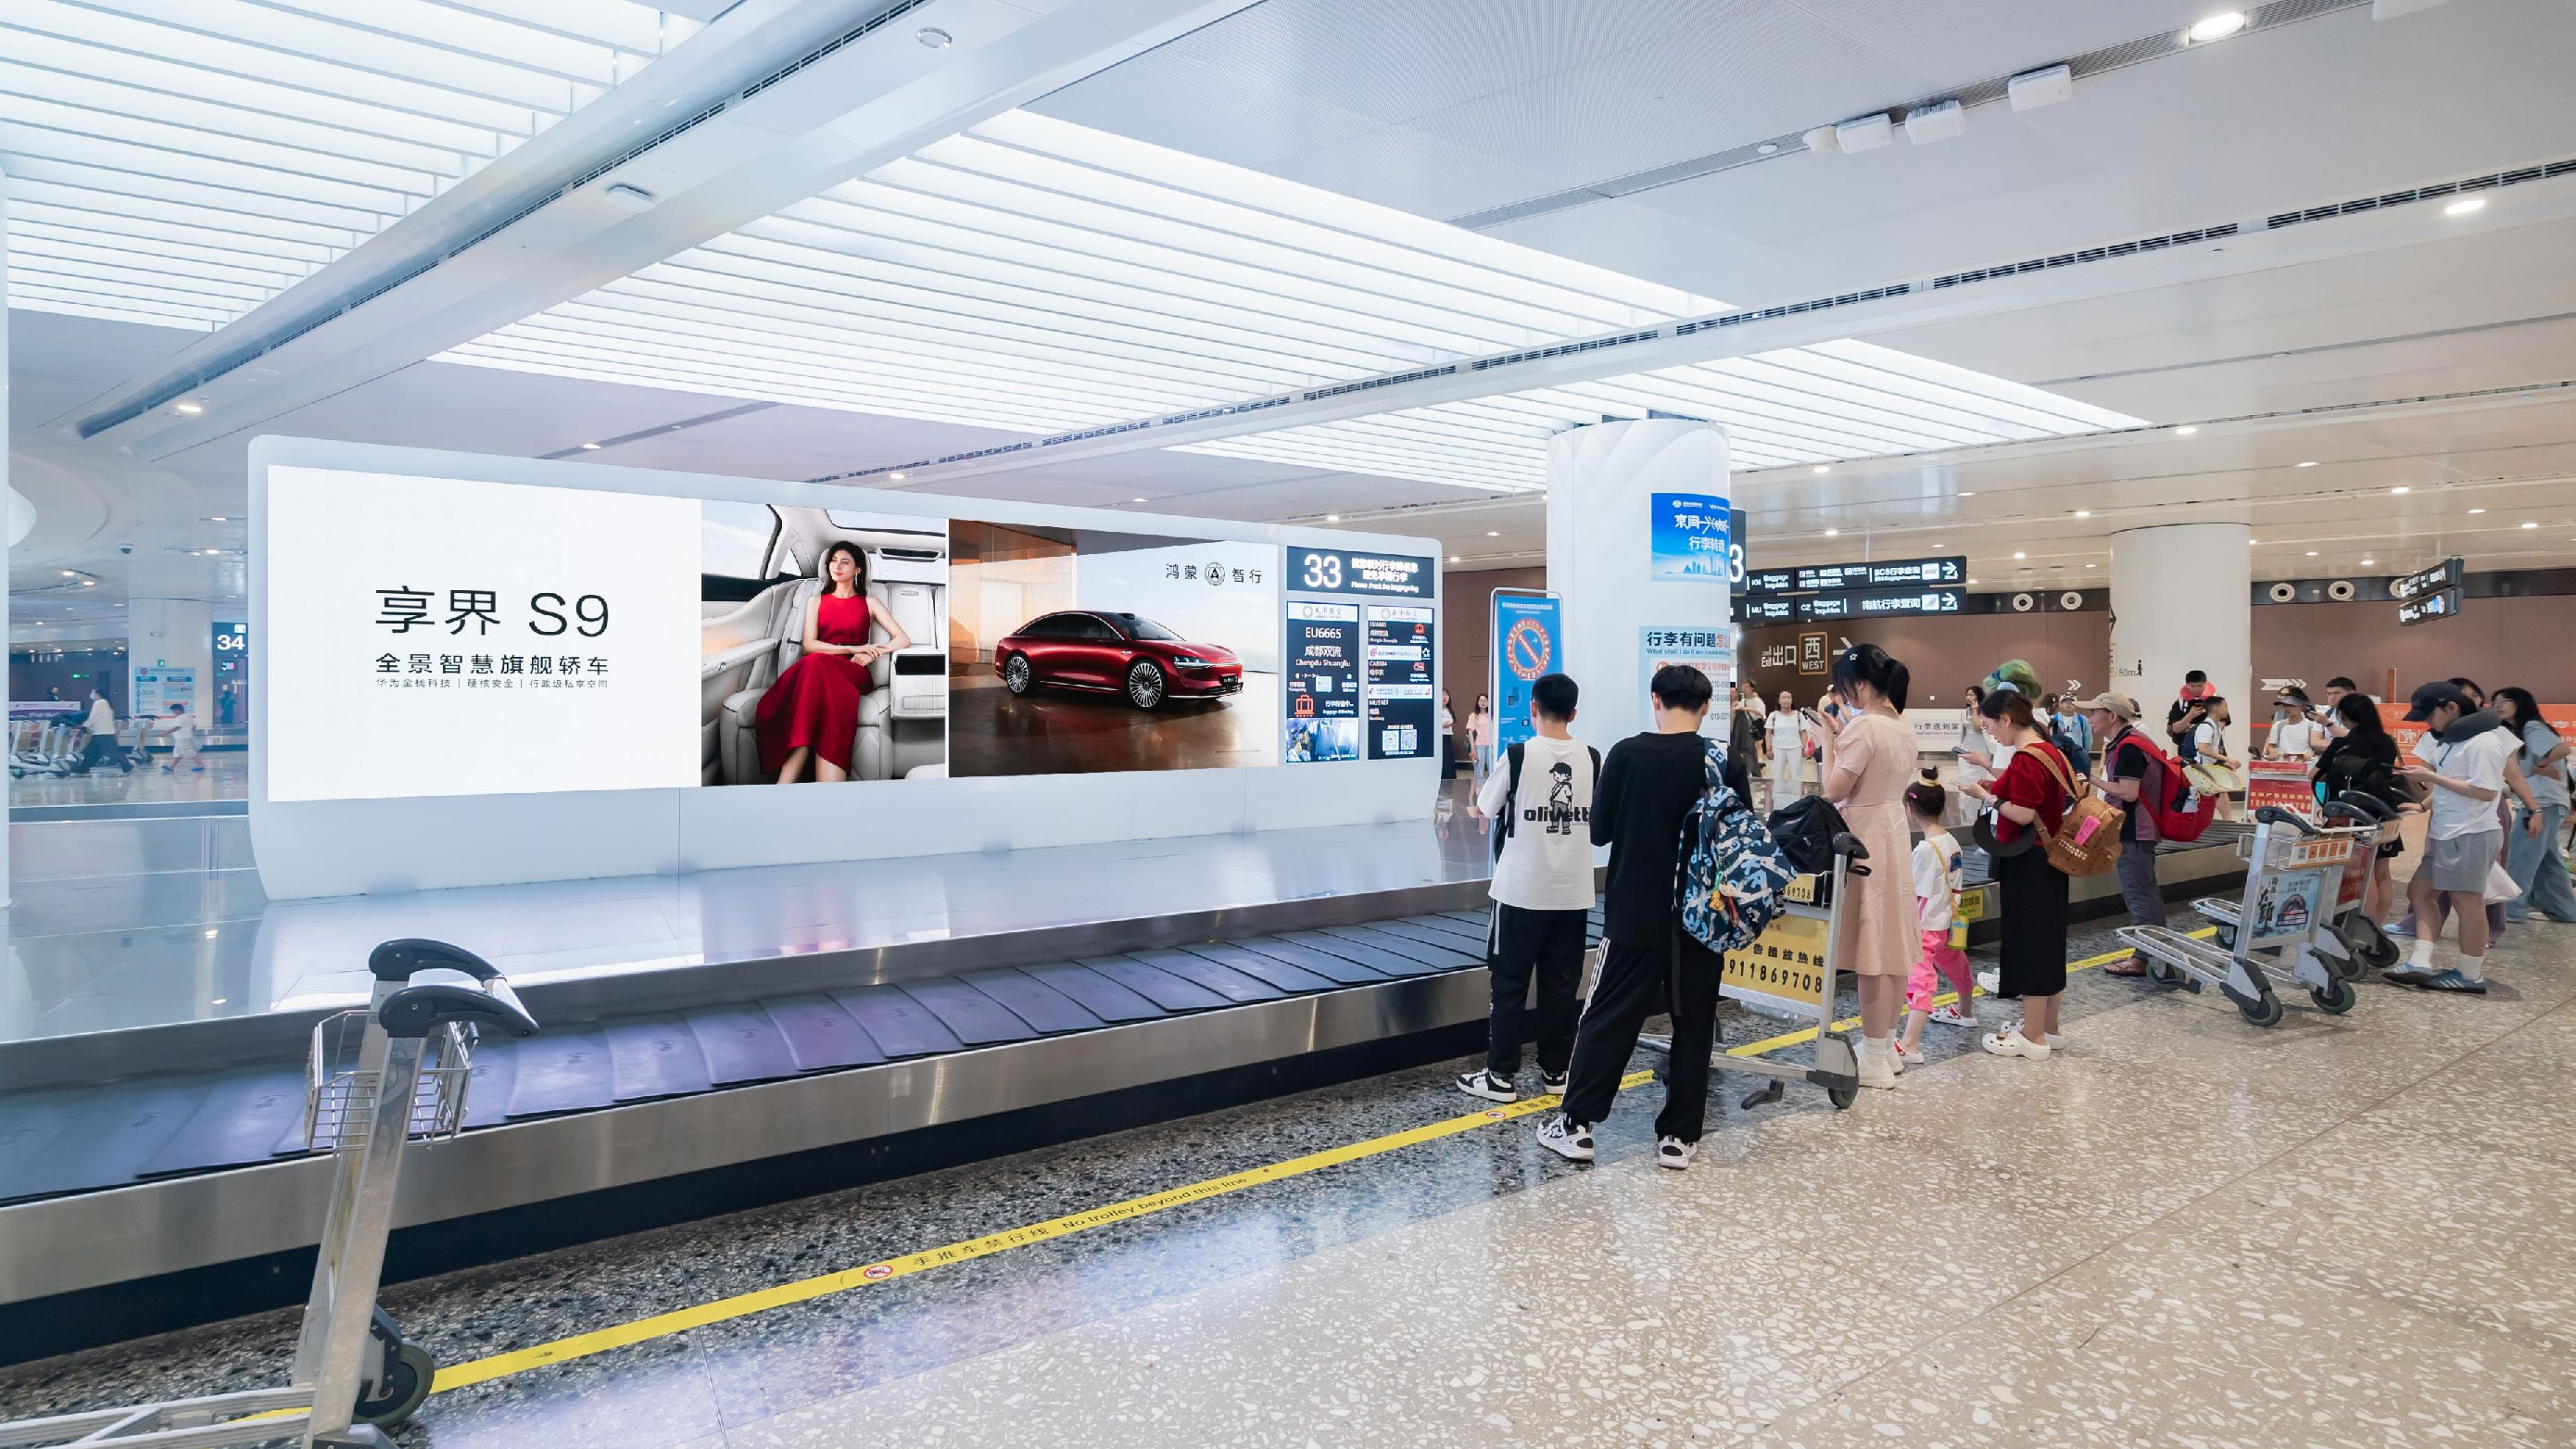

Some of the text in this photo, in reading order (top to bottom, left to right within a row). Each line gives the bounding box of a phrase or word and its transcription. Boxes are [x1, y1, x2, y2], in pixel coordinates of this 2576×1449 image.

[1166, 563, 1262, 584] 鸿蒙 智行
[1304, 554, 1342, 587] 33
[1751, 578, 1762, 586] KN
[375, 585, 609, 637] 享界 S9
[1800, 603, 1812, 611] CZ
[1305, 626, 1342, 639] EU6665
[217, 635, 246, 650] 34
[1305, 645, 1343, 658] 成都双流
[1805, 637, 1821, 660] 西
[375, 652, 609, 675] 全景智慧旗舰轿车
[1295, 659, 1351, 669] Chengdu Shuangliu
[1773, 645, 1797, 666] 出口
[1802, 661, 1824, 670] WEST
[467, 678, 513, 688] 硬核安全
[529, 679, 608, 688] 行政级私享空间
[1523, 806, 1590, 823] olivett
[1729, 959, 1823, 993] 911869708
[1062, 1217, 1085, 1229] No
[1089, 1206, 1135, 1222] trolley
[1138, 1191, 1192, 1209] beyond
[1193, 1185, 1219, 1196] this
[913, 1227, 1050, 1266] 手推车禁行线
